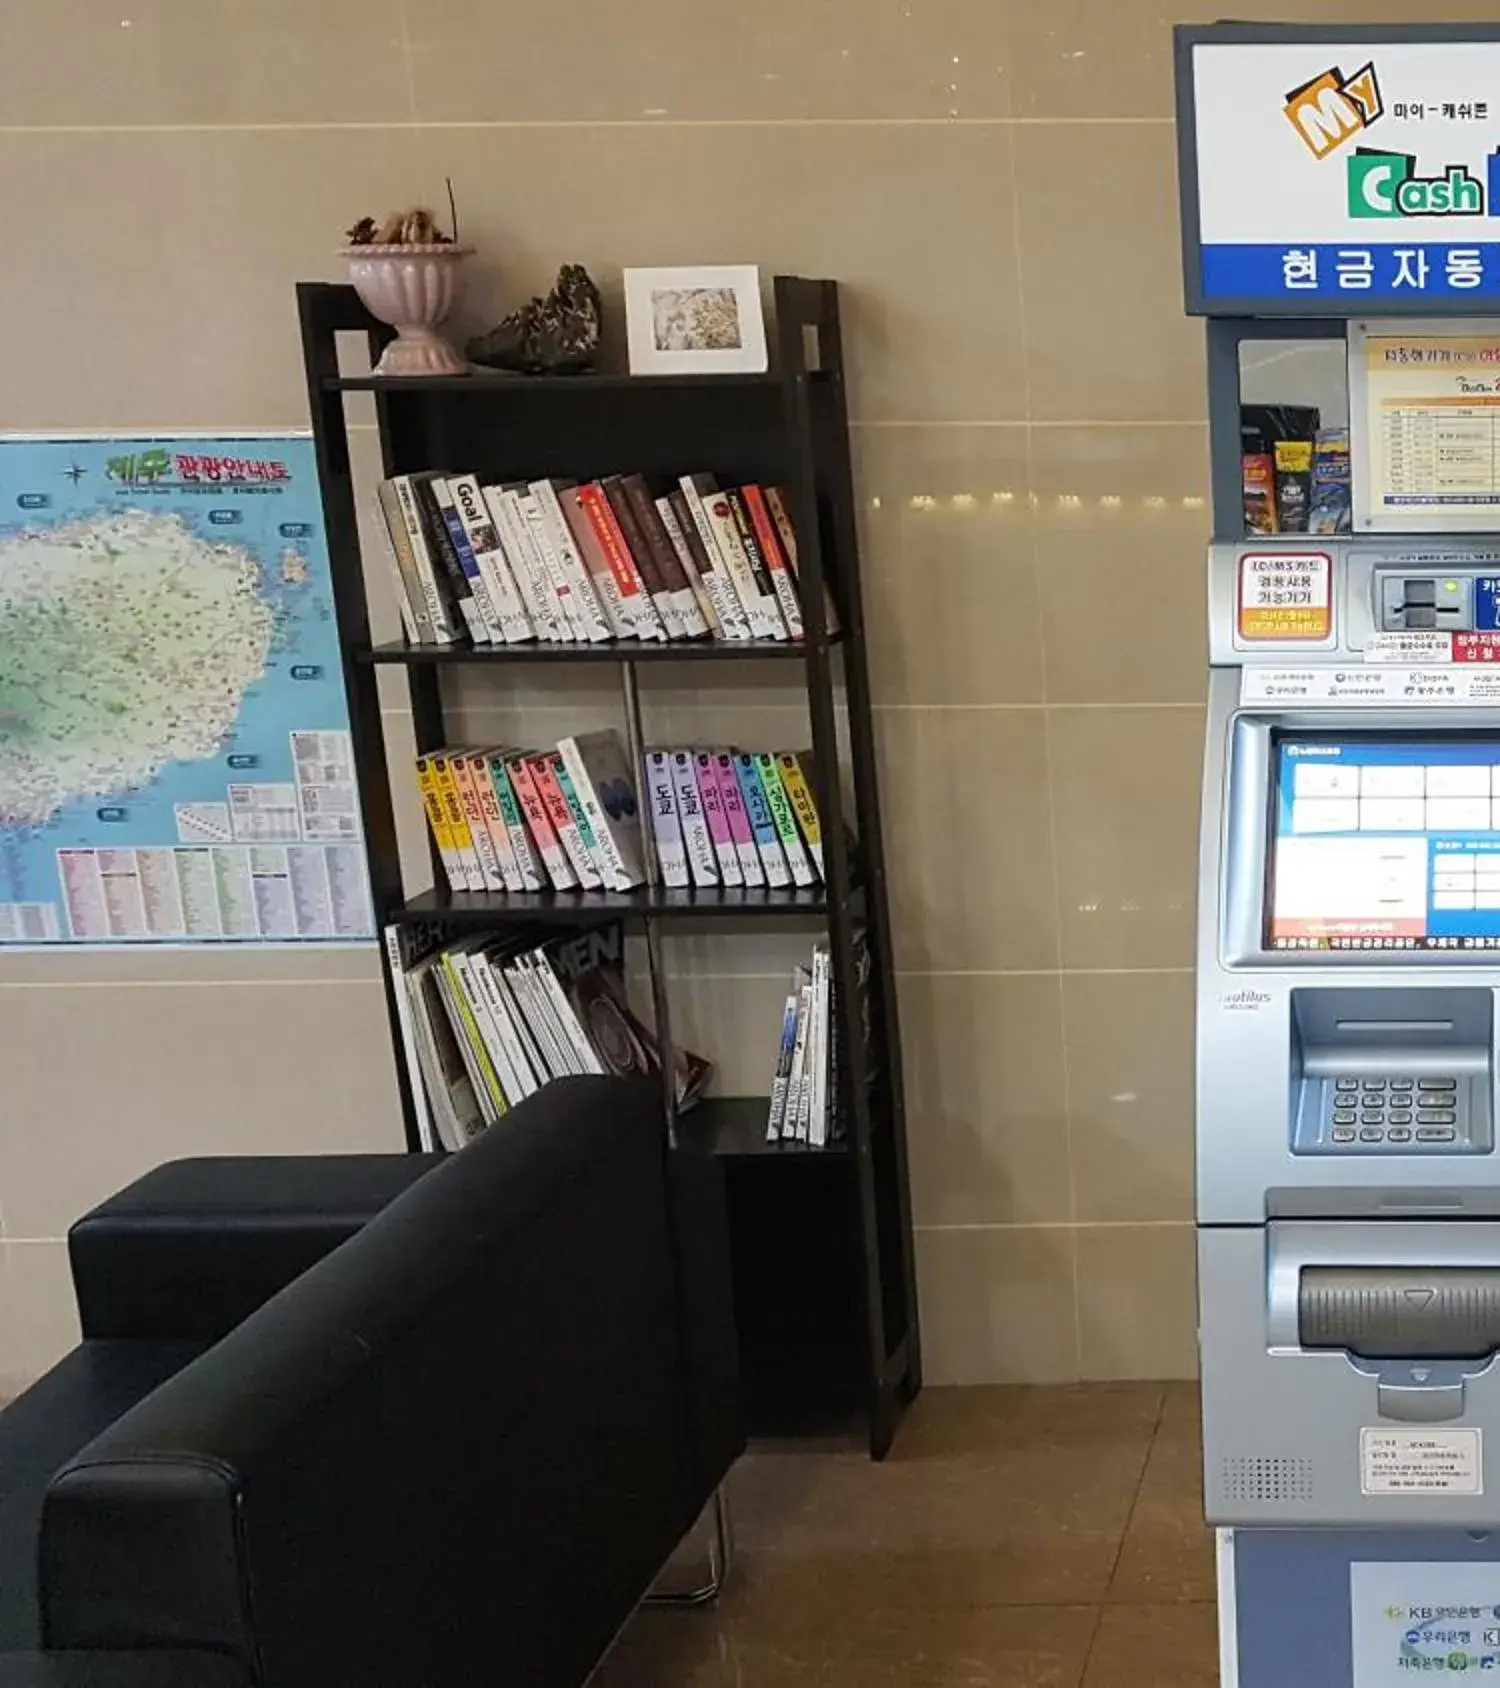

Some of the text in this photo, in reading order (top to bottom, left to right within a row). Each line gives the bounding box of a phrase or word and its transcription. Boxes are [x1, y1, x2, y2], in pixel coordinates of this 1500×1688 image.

[1284, 62, 1384, 158] My
[1361, 163, 1485, 216] Cash
[457, 483, 485, 523] Goal
[1409, 1606, 1432, 1618] KB
